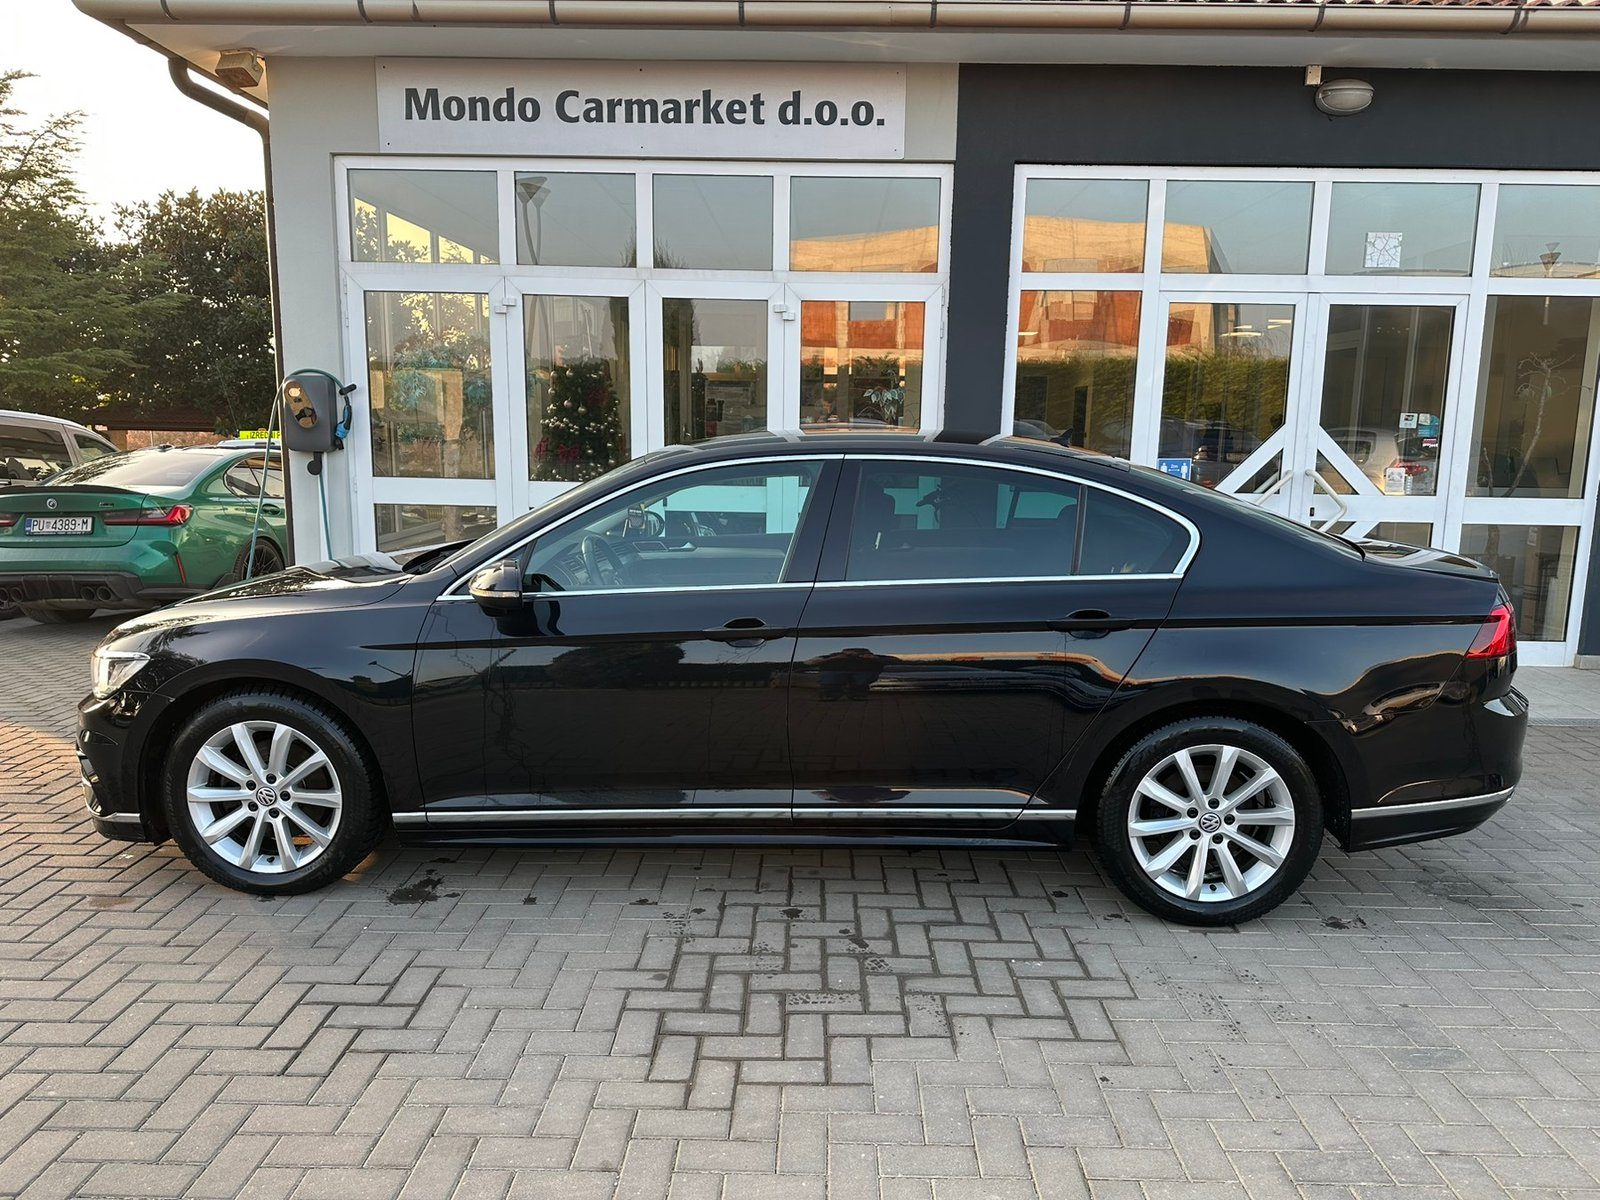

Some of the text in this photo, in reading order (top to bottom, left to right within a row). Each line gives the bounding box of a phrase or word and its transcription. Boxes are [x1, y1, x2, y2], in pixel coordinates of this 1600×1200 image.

[404, 87, 885, 126] Mondo Carmarket d.o.o.
[32, 519, 45, 531] PU
